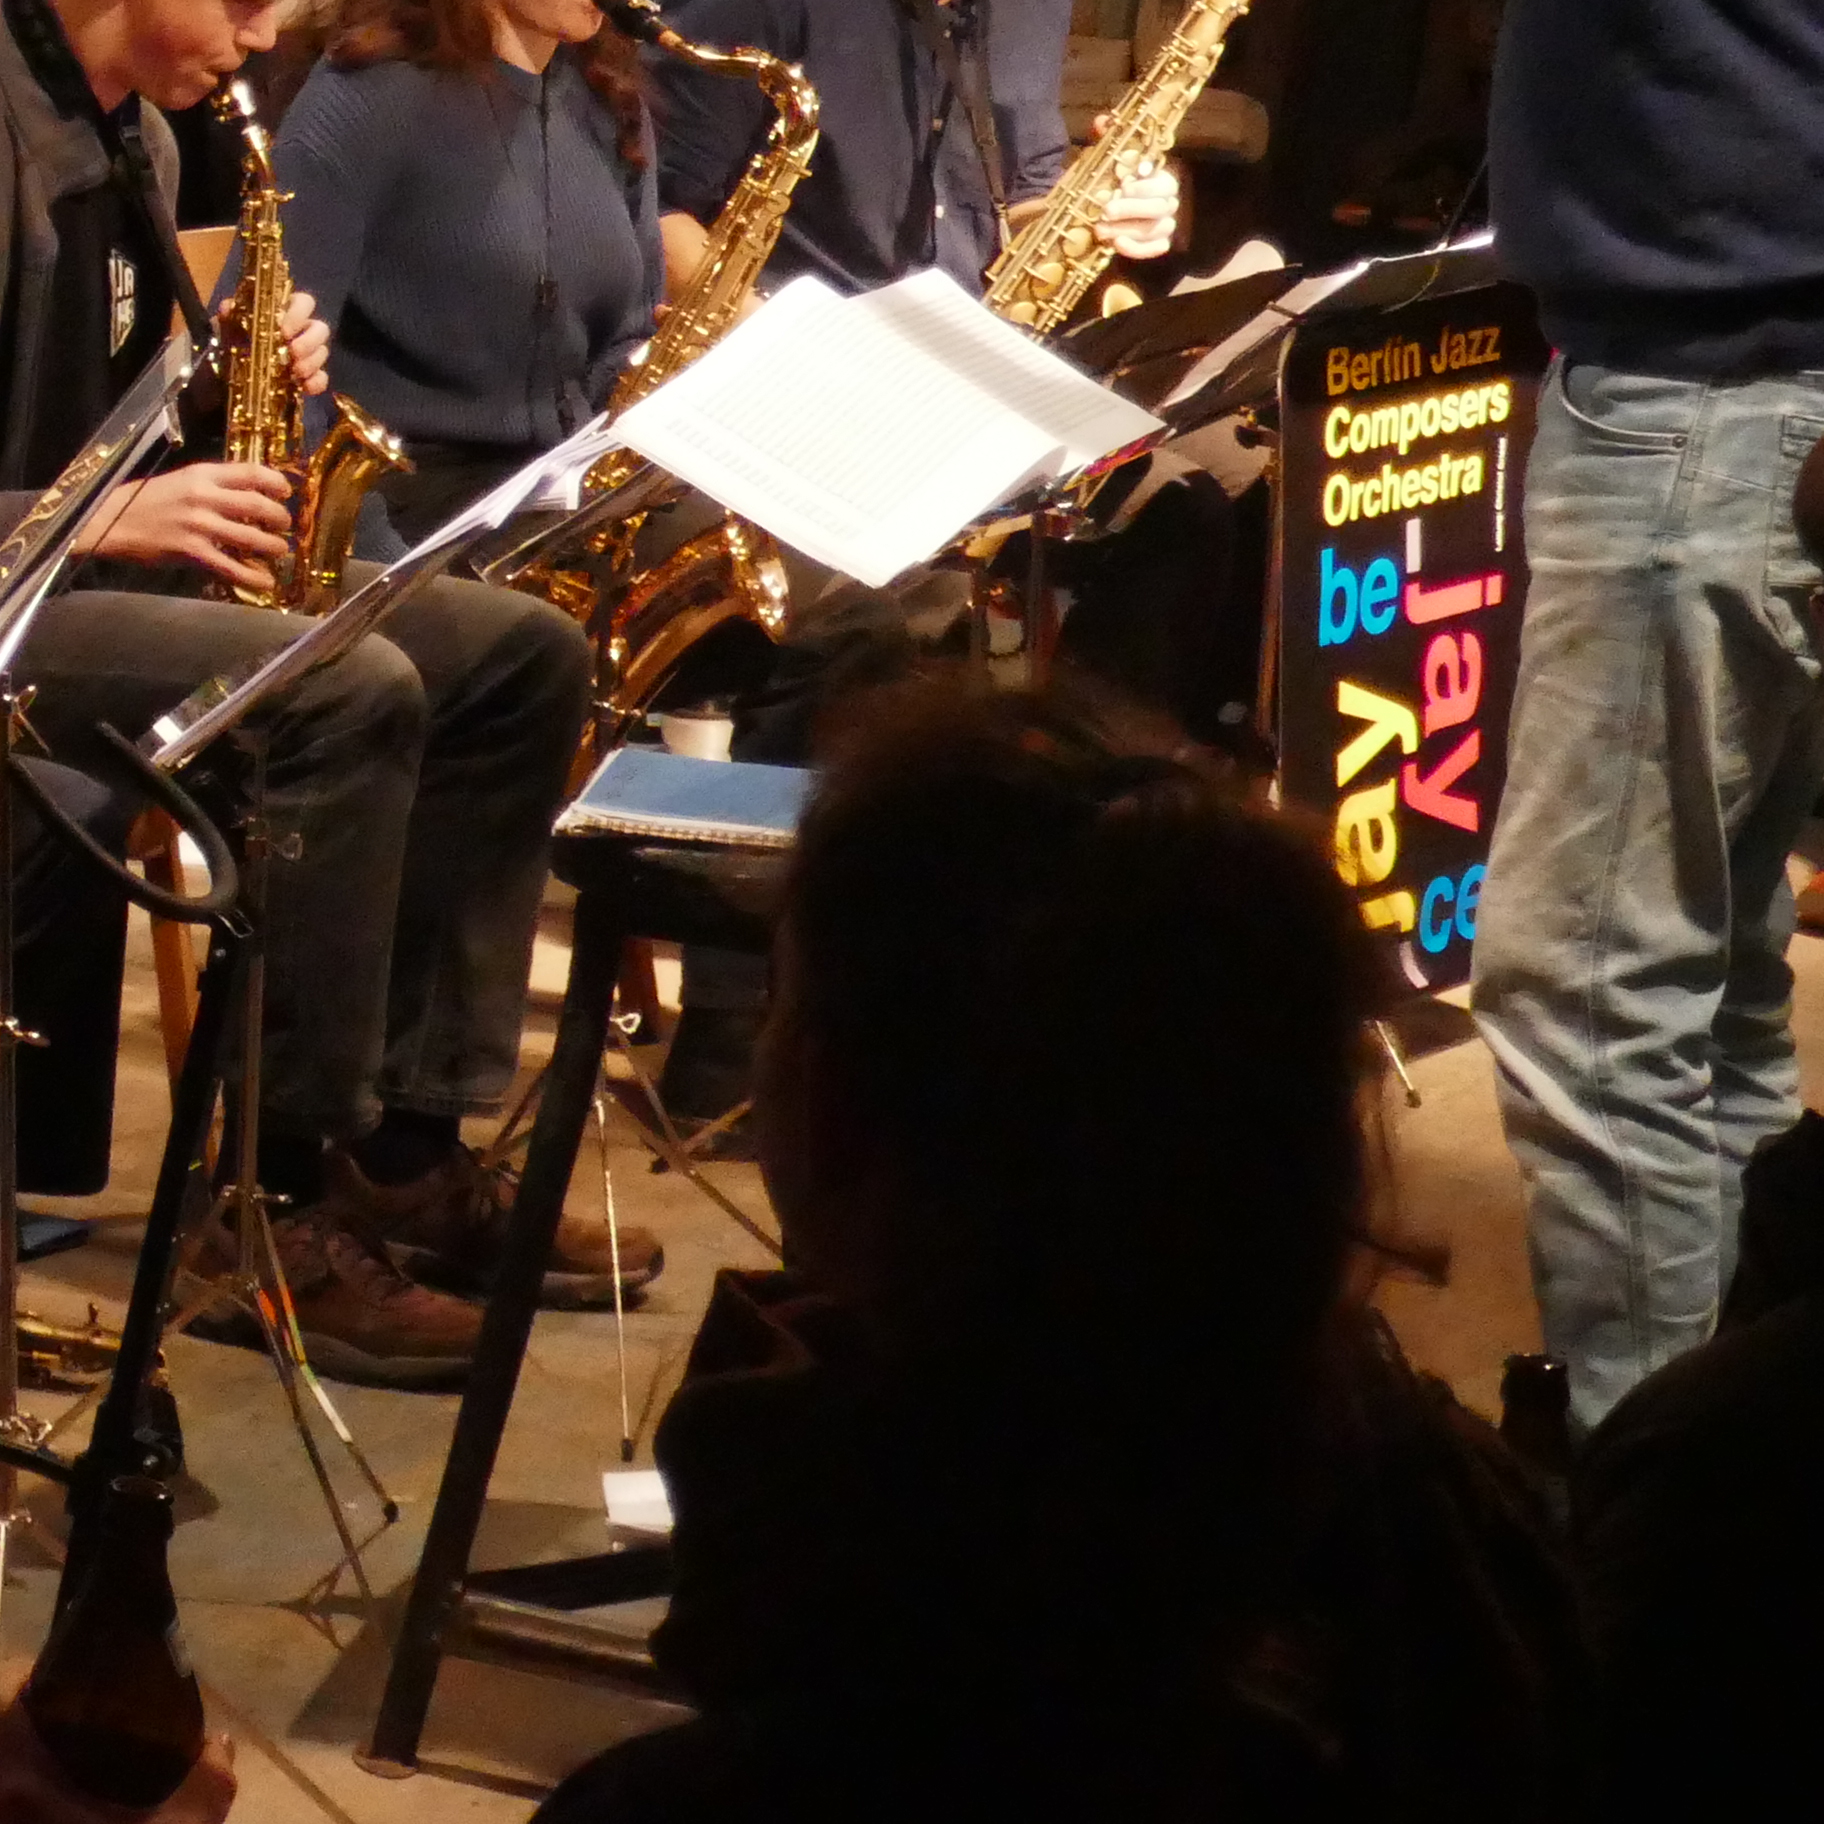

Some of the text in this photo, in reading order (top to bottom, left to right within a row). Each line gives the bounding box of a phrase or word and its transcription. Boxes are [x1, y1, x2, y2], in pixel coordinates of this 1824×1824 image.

[1327, 326, 1501, 396] Berlin Jazz
[1324, 381, 1511, 459] Composers
[1322, 453, 1483, 527] Orchestra
[1317, 547, 1399, 648] be
[1399, 573, 1505, 833] jay
